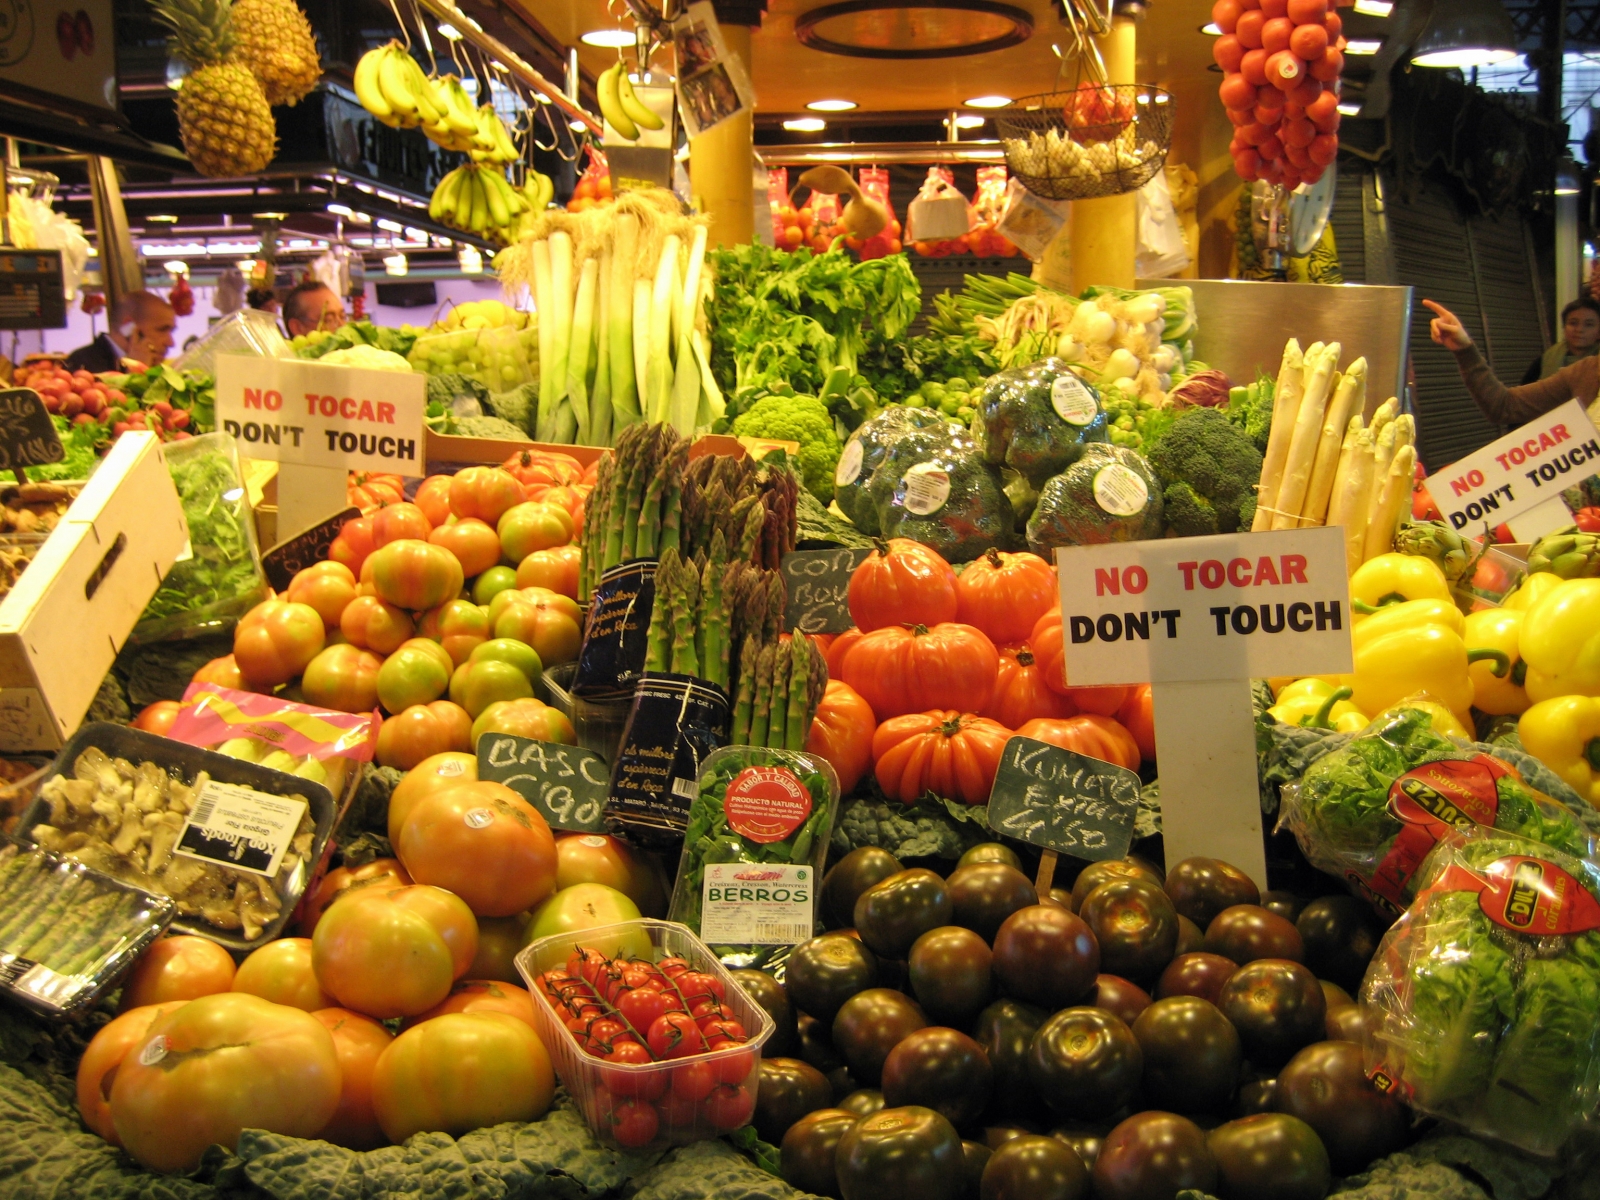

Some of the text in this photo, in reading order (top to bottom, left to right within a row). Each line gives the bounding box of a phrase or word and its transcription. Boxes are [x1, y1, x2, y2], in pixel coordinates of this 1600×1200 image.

[243, 387, 396, 424] NO TOCAR
[223, 419, 415, 460] DON'T TOUCH
[1449, 423, 1571, 497] NO TOCAR
[1448, 438, 1600, 530] DON'T TOUCH
[1095, 554, 1308, 596] NO TOCAR
[1069, 600, 1342, 644] DON'T TOUCH
[488, 738, 607, 786] BASC
[624, 743, 675, 760] els millors
[731, 796, 804, 810] PRODUCTO NATURAL
[739, 774, 763, 793] SABOR
[774, 774, 800, 798] CALIDAD
[1405, 780, 1472, 832] DULZE
[1427, 769, 1491, 815] corazones
[200, 826, 240, 847] foods
[709, 888, 808, 902] BERROS
